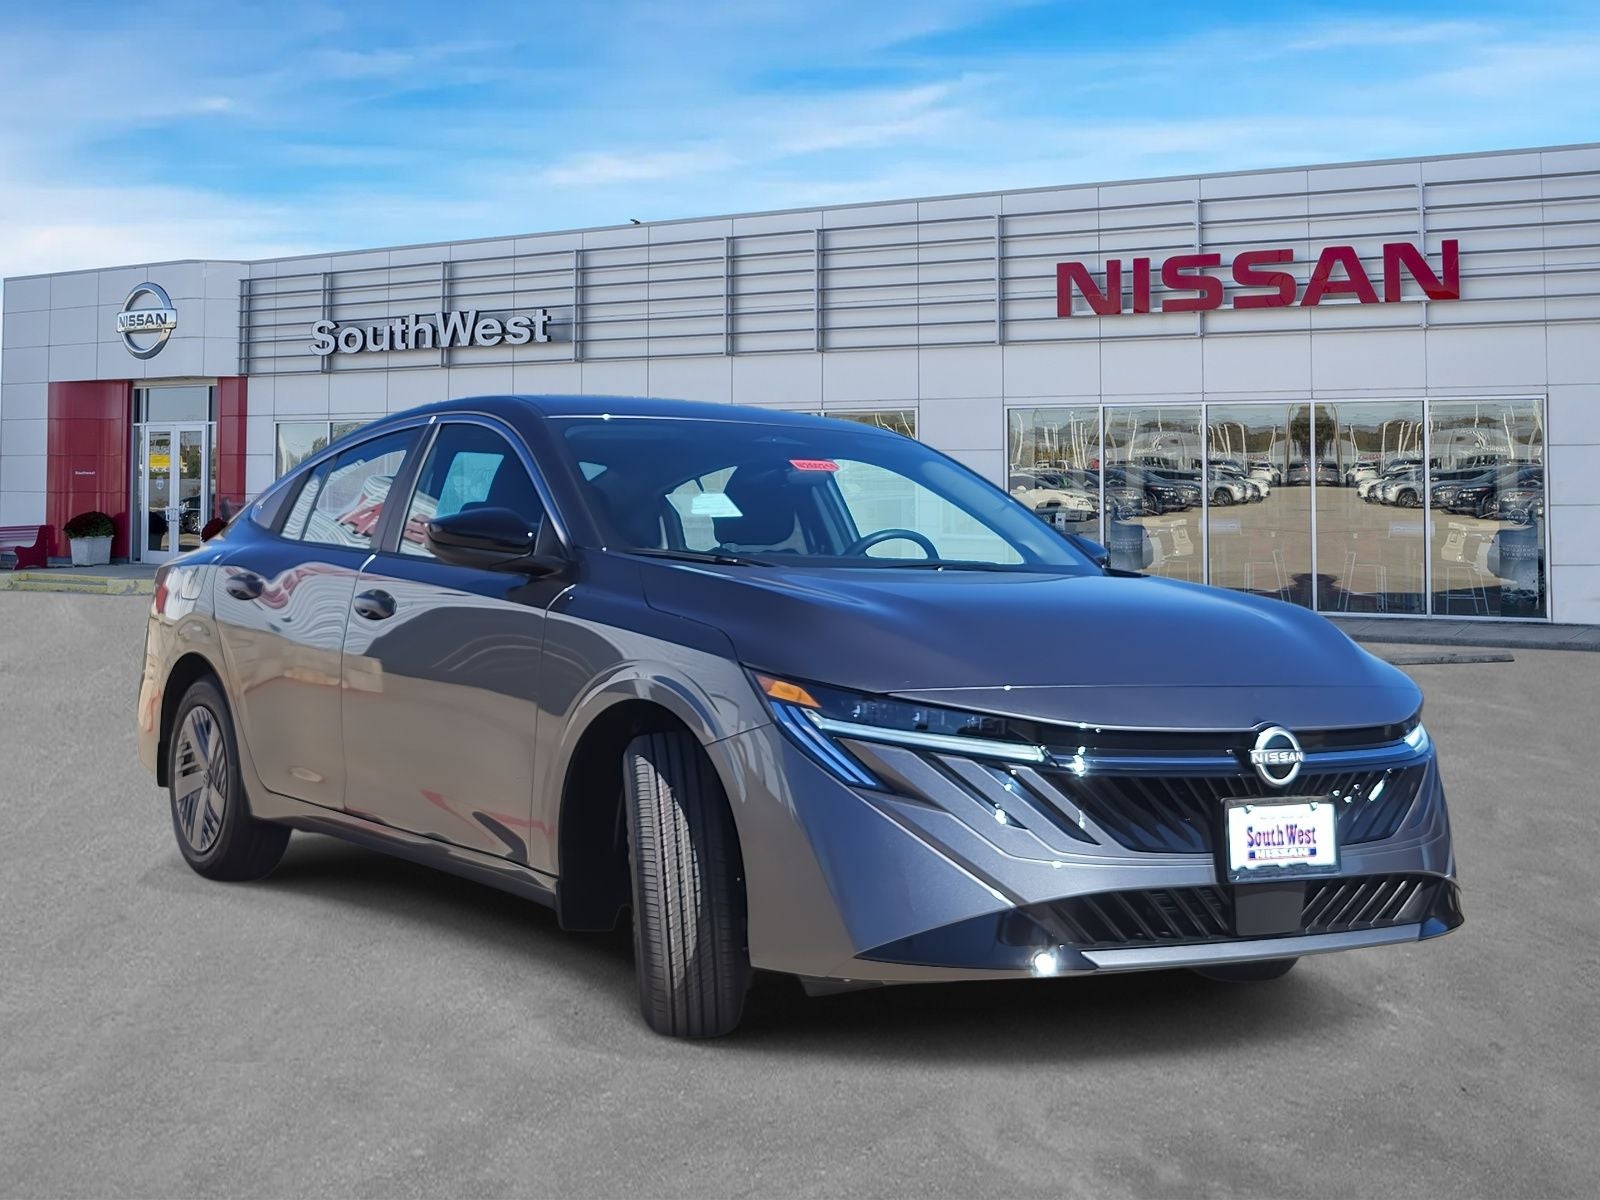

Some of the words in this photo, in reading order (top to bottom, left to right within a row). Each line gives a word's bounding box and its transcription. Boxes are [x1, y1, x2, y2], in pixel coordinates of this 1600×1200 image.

[1056, 239, 1461, 318] NISSAN
[119, 312, 167, 328] NISSAN
[310, 308, 551, 356] SouthWest
[1251, 751, 1304, 764] NISSAN
